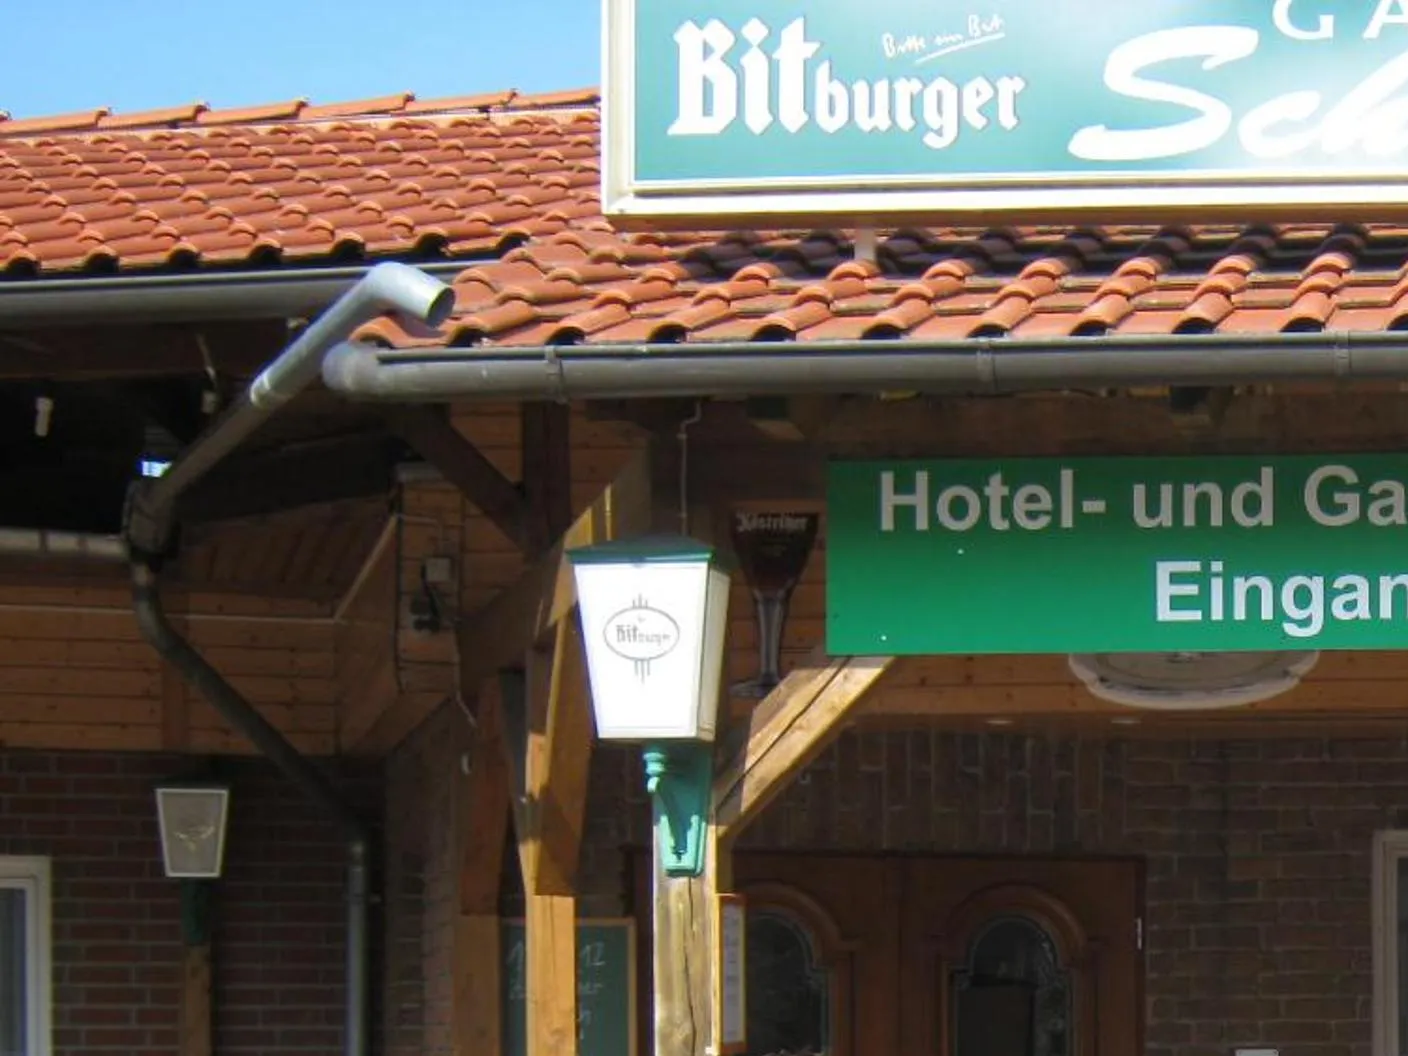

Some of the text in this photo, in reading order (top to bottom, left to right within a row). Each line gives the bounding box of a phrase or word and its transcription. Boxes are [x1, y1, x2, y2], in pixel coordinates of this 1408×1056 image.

[667, 17, 1025, 149] Bitburger
[879, 469, 1106, 532] Hotel-
[1131, 466, 1274, 528] und
